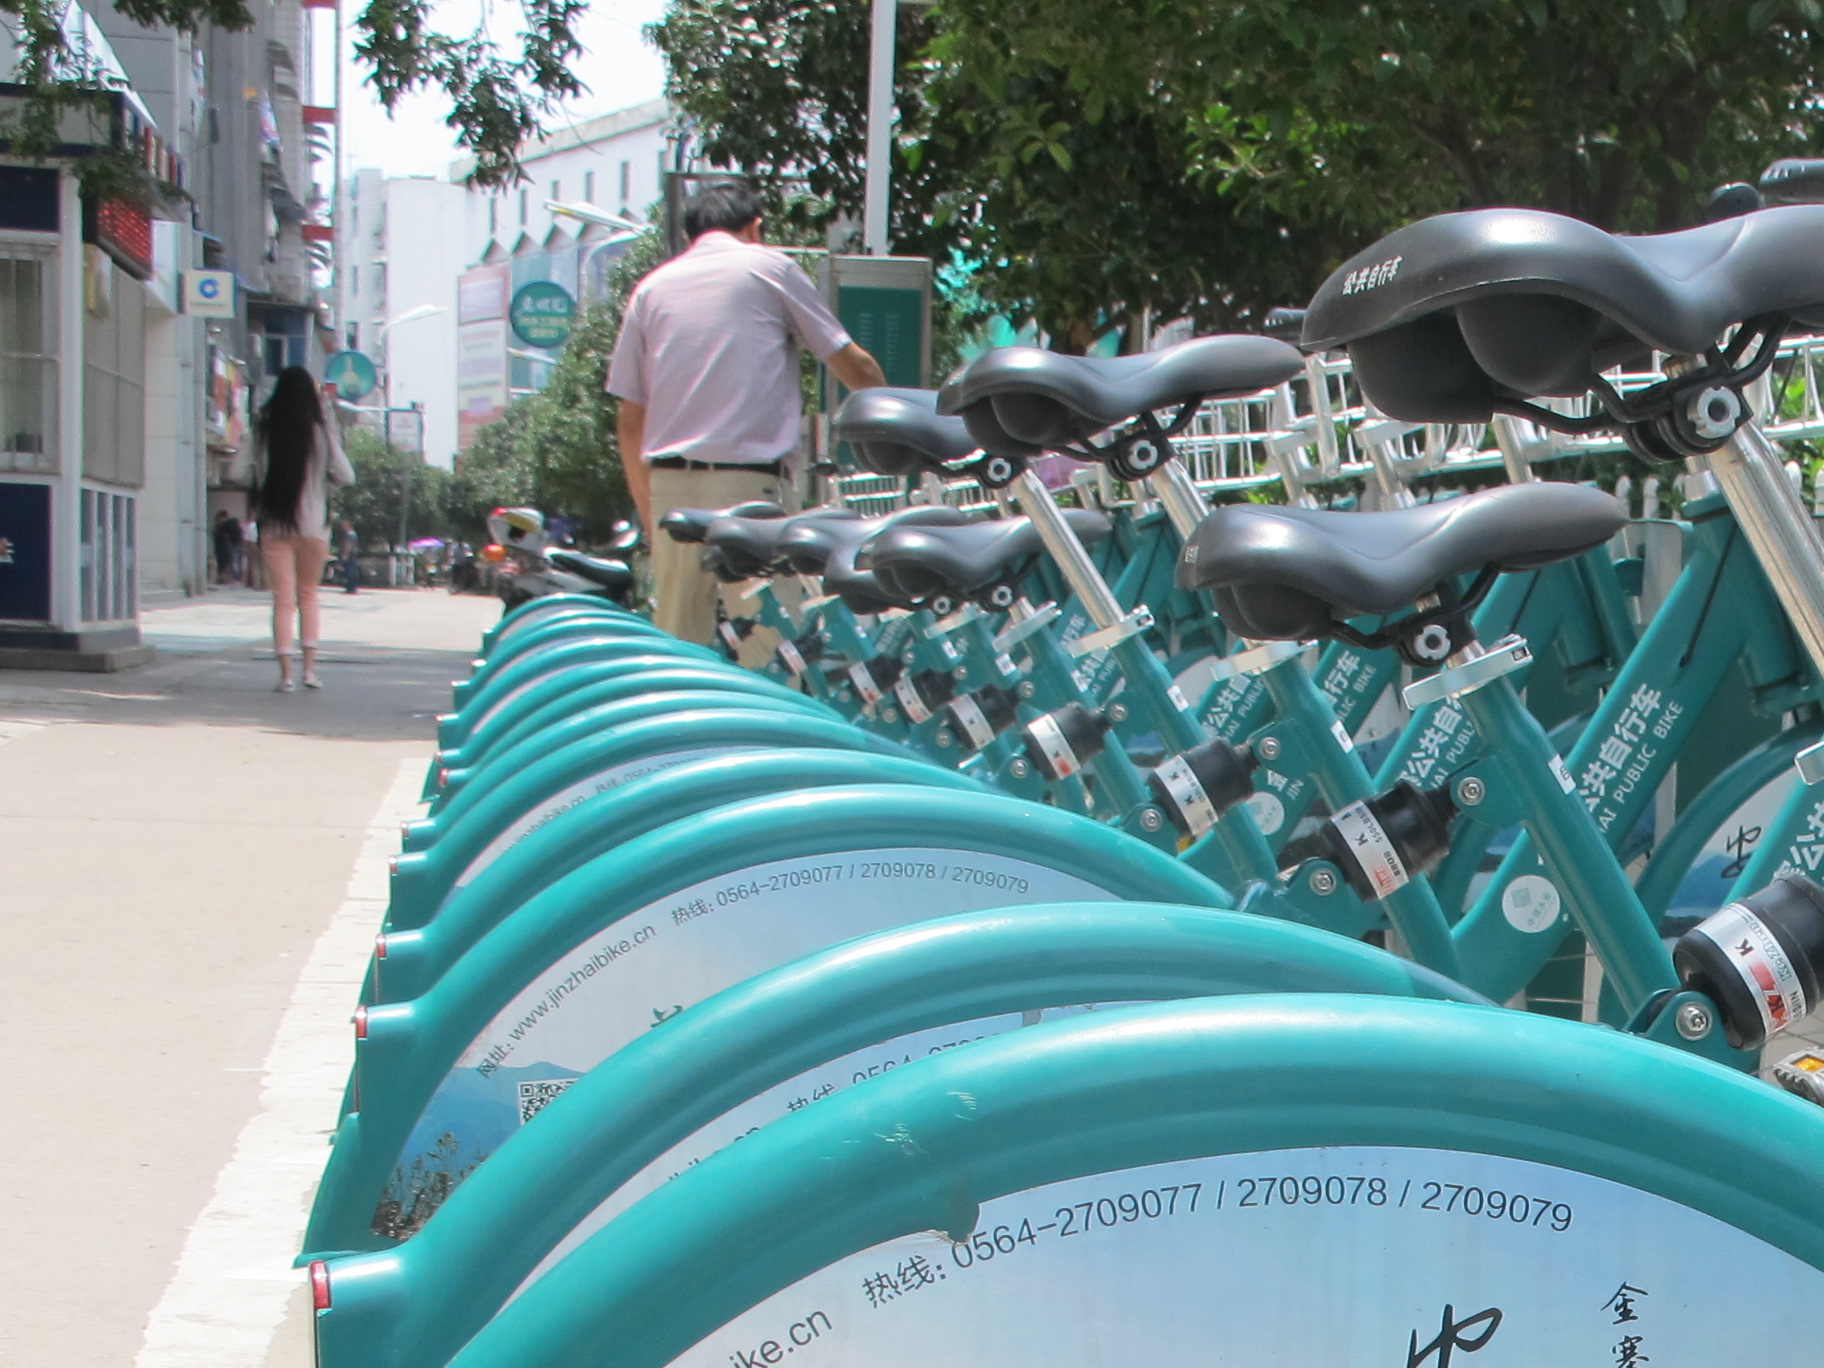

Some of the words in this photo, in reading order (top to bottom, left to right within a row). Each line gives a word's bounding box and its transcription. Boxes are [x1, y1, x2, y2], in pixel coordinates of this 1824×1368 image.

[1342, 255, 1403, 296] 公共自行车
[1323, 650, 1361, 705] 行车
[1397, 697, 1463, 788] 公共自
[1612, 743, 1656, 804] PUBLIC
[1652, 701, 1684, 739] BIKE
[508, 923, 656, 1042] www.jinzhaibike.cn
[715, 863, 844, 907] 0564-2709077
[861, 862, 936, 880] 2709078
[952, 865, 1030, 895] 2709079
[861, 1253, 948, 1309] 热线:
[950, 1182, 1204, 1271] 0564-2709077
[1236, 1174, 1388, 1208] 2709078
[1420, 1181, 1574, 1233] 2709079
